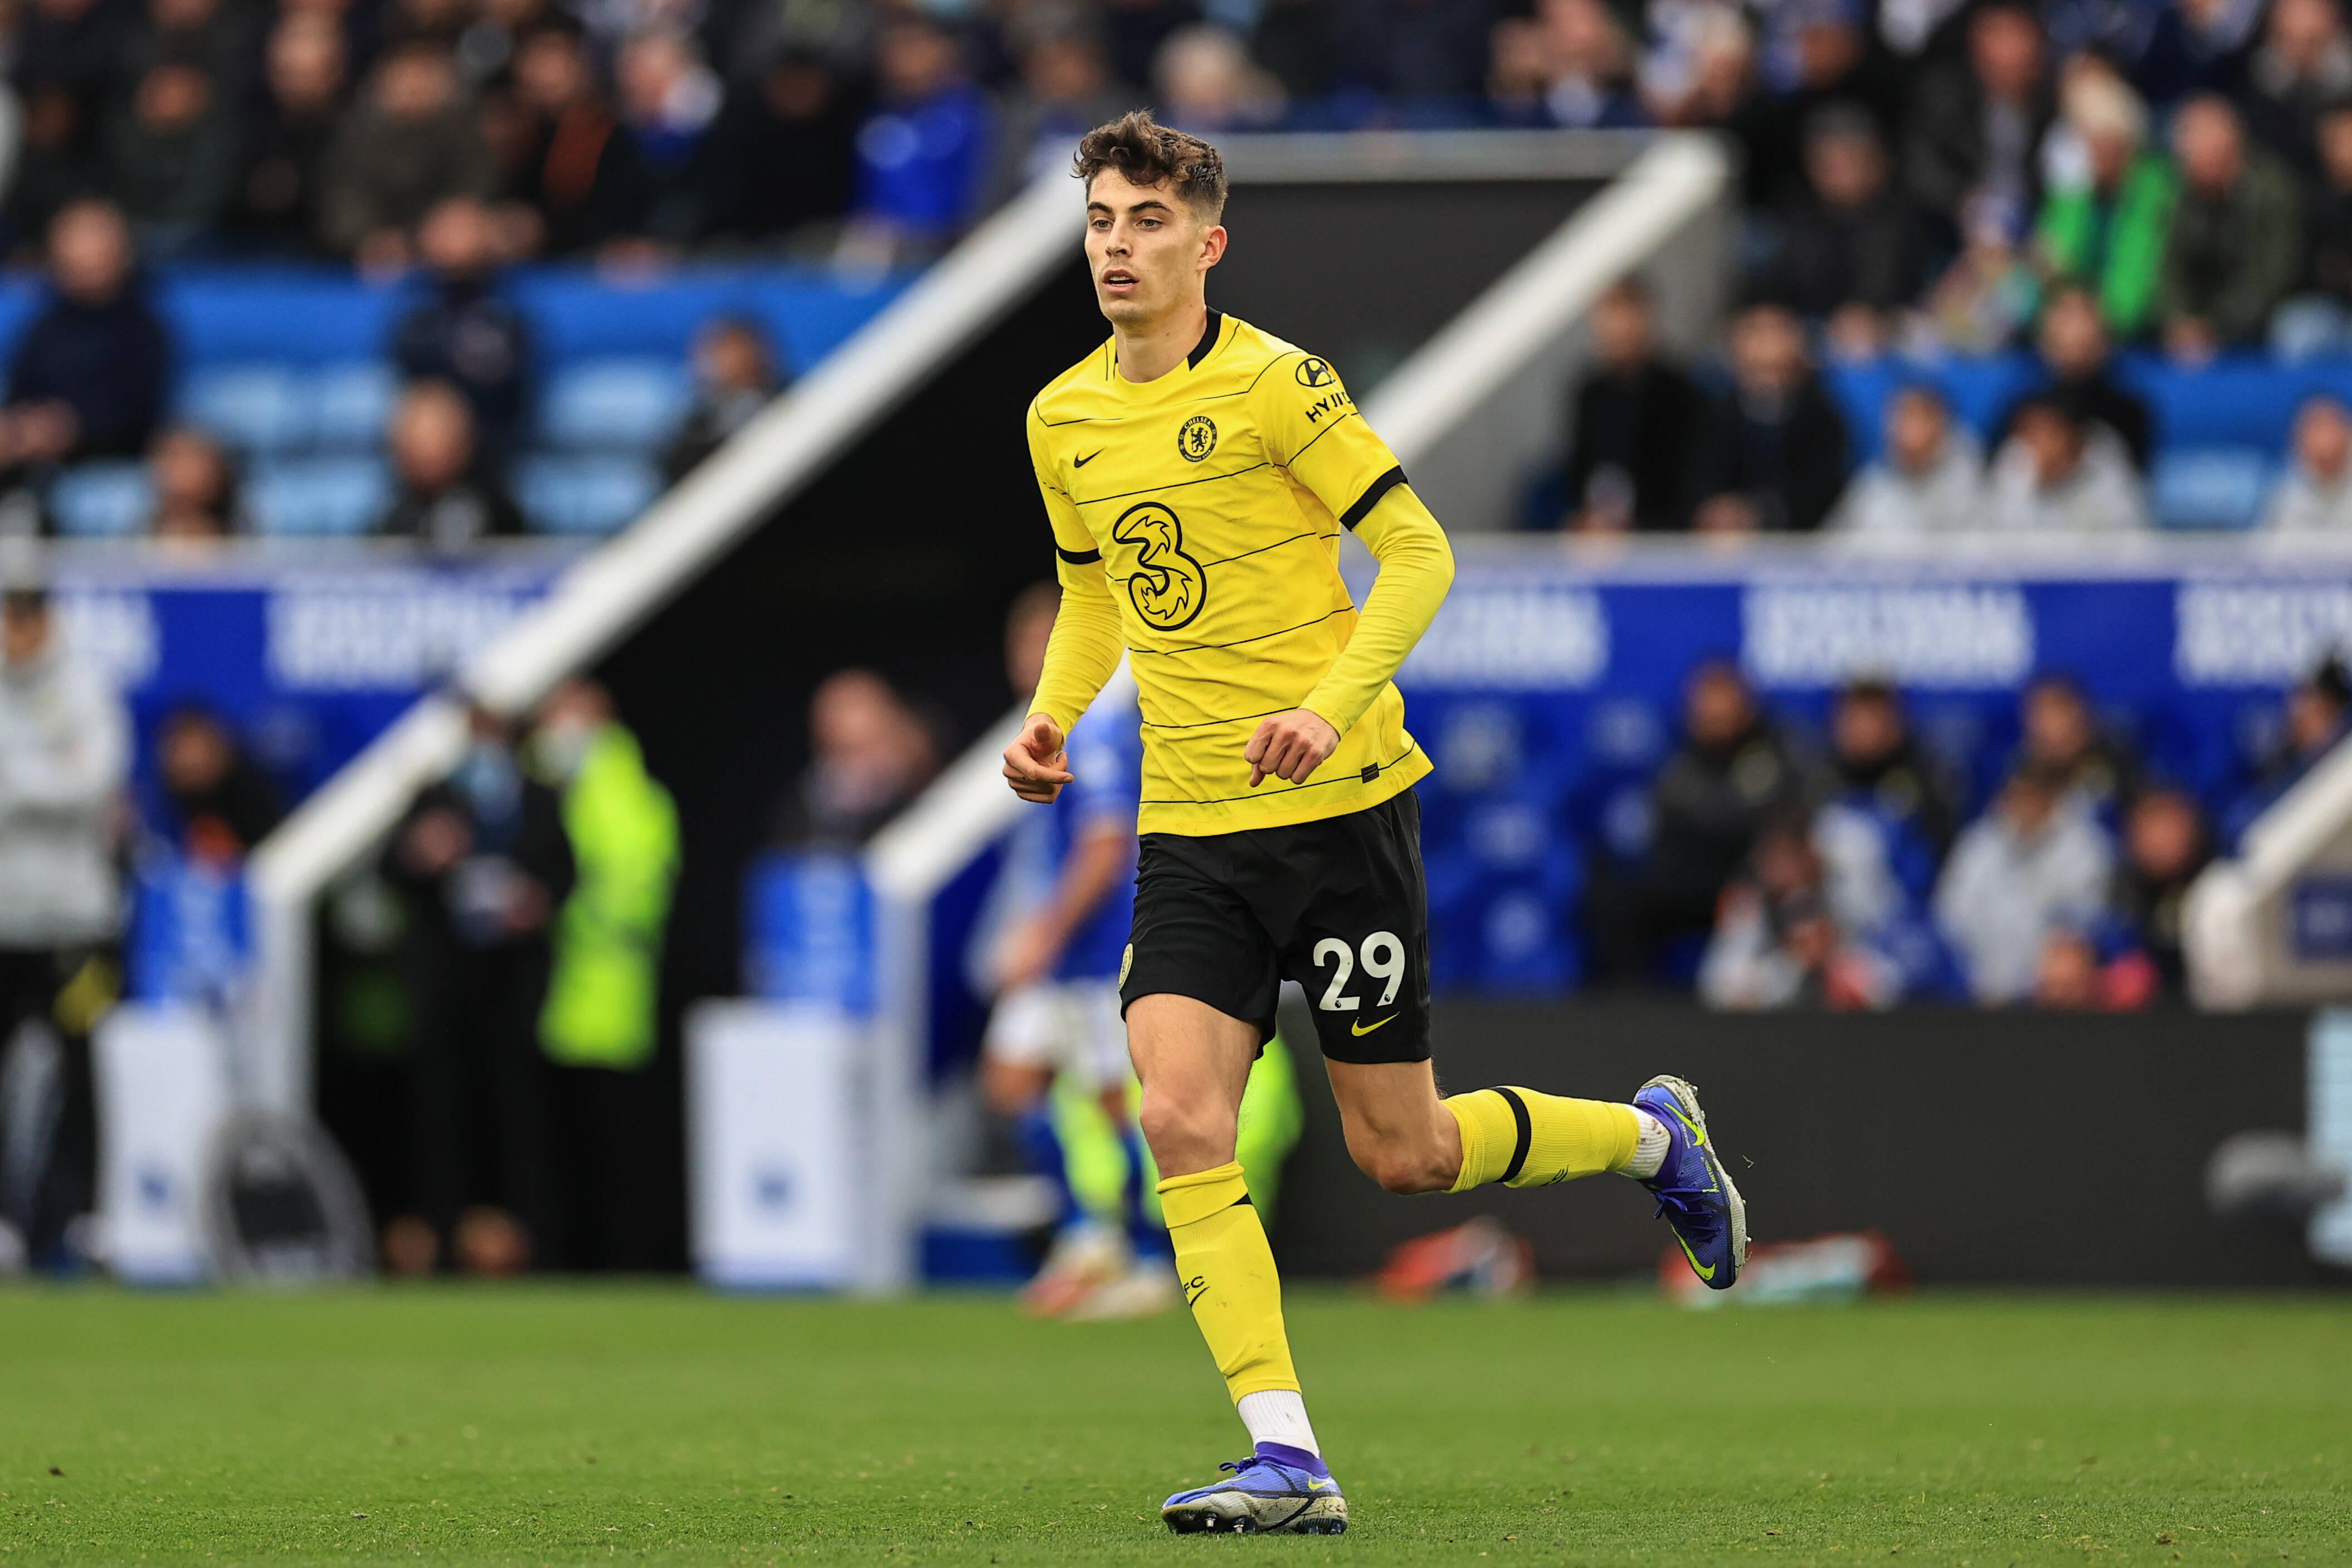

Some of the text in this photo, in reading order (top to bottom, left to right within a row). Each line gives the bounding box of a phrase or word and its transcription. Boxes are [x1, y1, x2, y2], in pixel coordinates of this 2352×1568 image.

[1185, 417, 1211, 428] CHELSEA
[1112, 501, 1207, 631] 3
[1313, 931, 1405, 1011] 29
